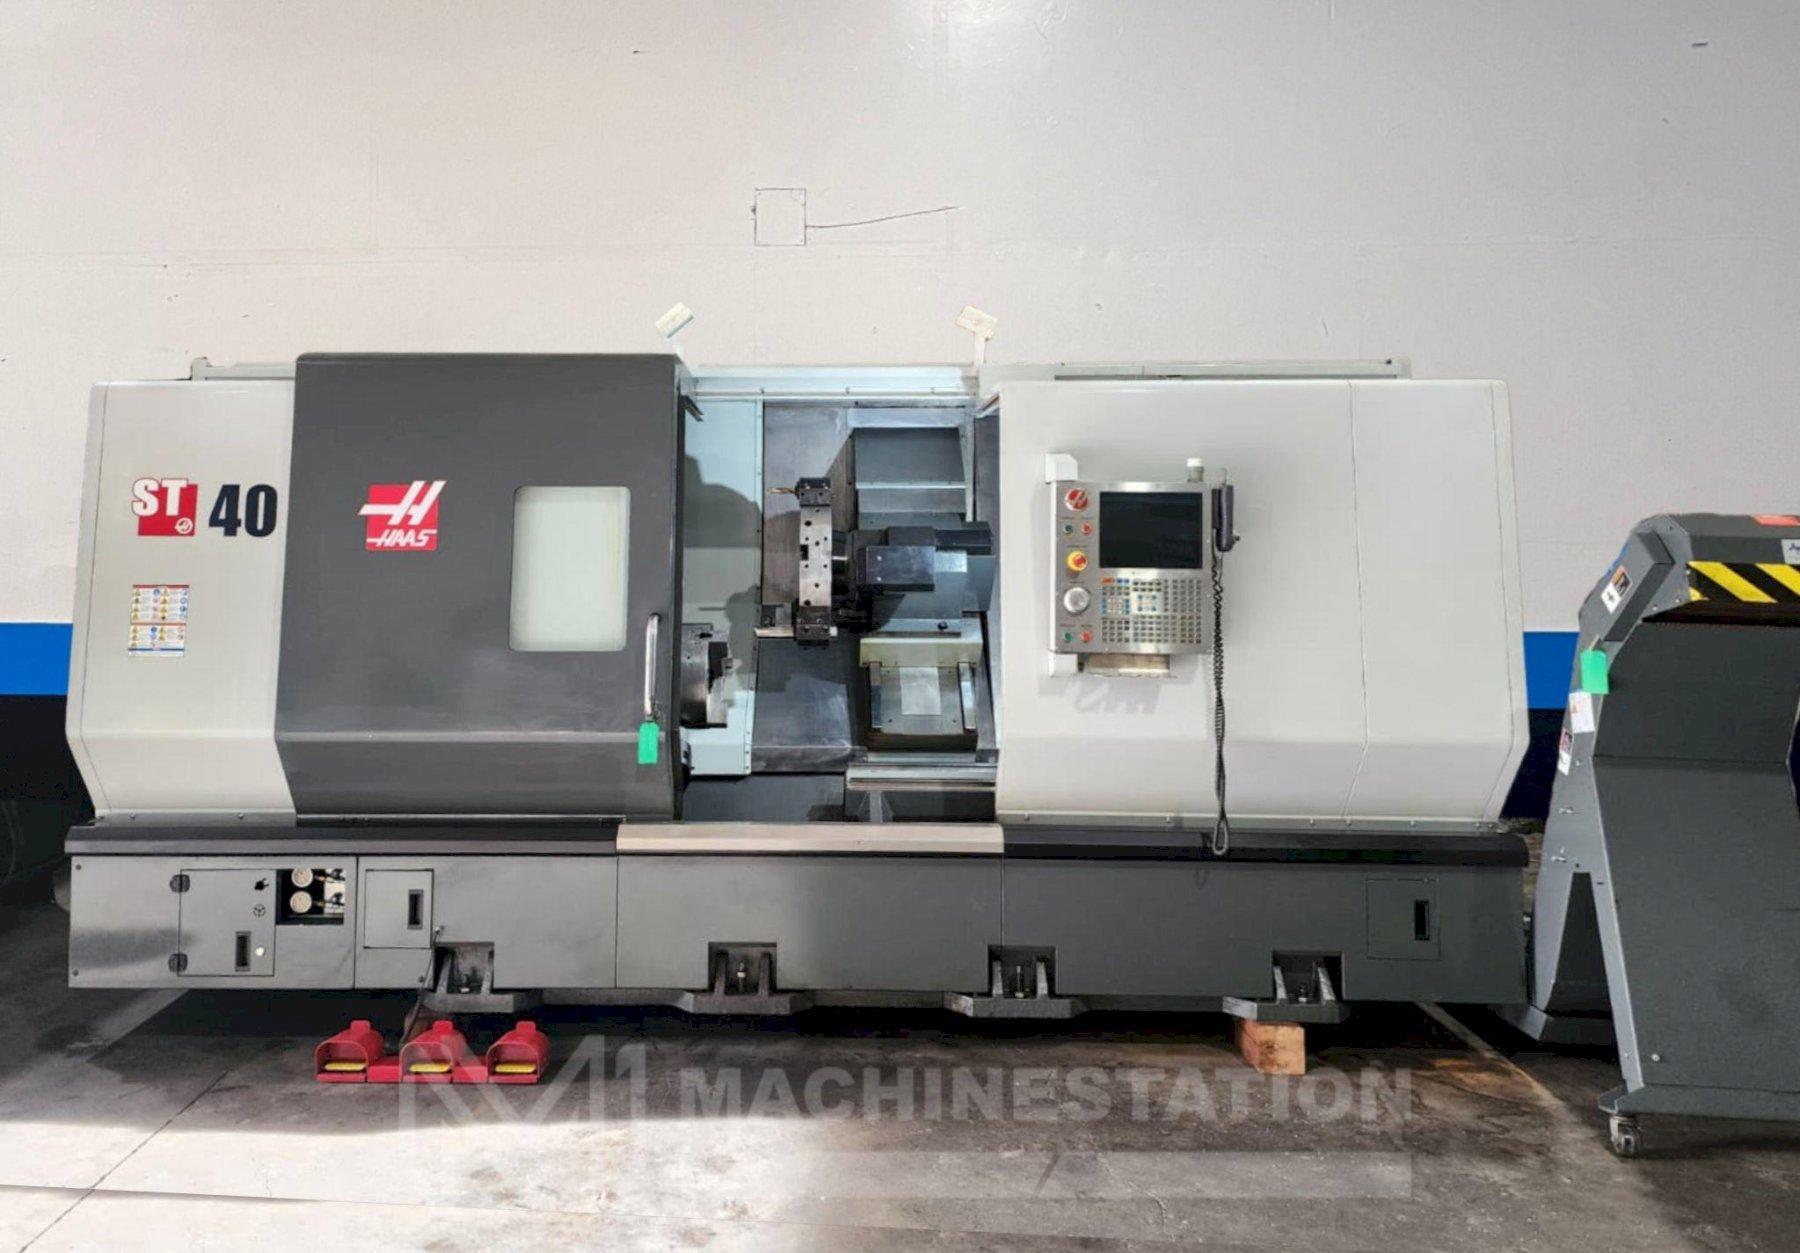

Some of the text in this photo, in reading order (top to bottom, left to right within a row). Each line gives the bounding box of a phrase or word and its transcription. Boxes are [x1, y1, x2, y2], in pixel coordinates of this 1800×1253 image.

[131, 477, 278, 537] ST 40
[366, 529, 438, 547] HAAS
